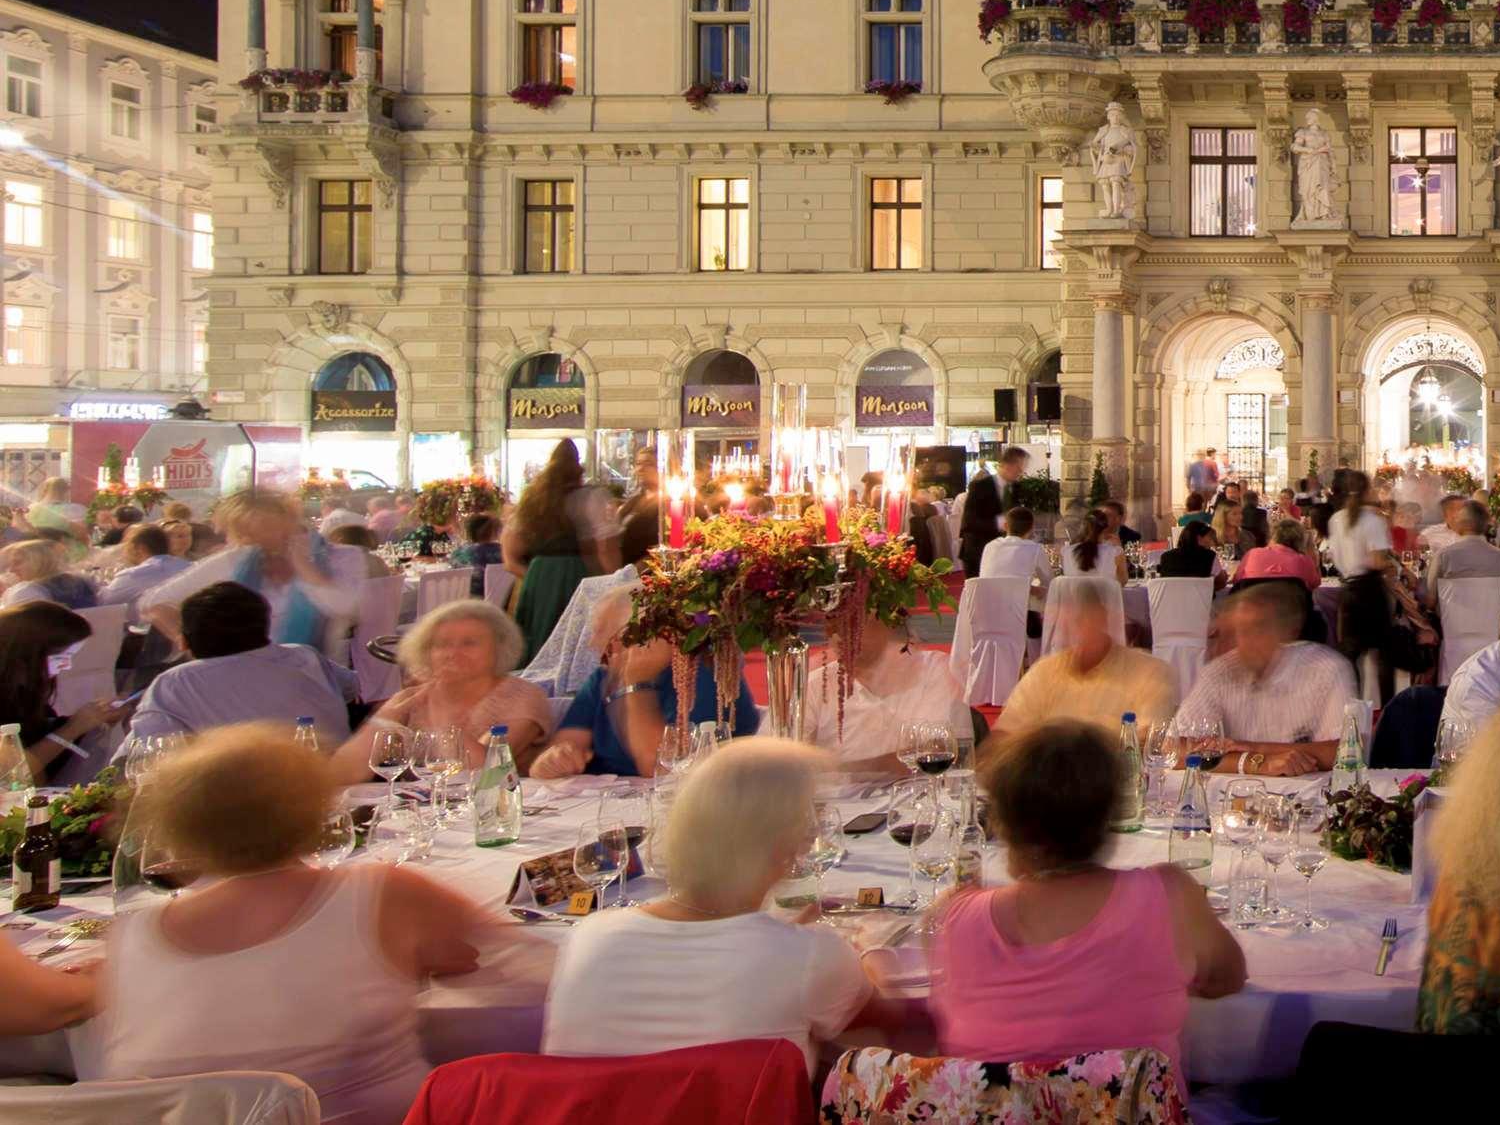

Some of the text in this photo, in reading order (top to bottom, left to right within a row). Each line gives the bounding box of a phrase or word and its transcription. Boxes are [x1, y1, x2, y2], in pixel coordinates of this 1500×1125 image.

[313, 402, 395, 421] Accessorize
[512, 398, 579, 420] Monsoon
[688, 394, 753, 417] Monsoon
[862, 395, 928, 416] Monsoon
[575, 897, 586, 909] 10
